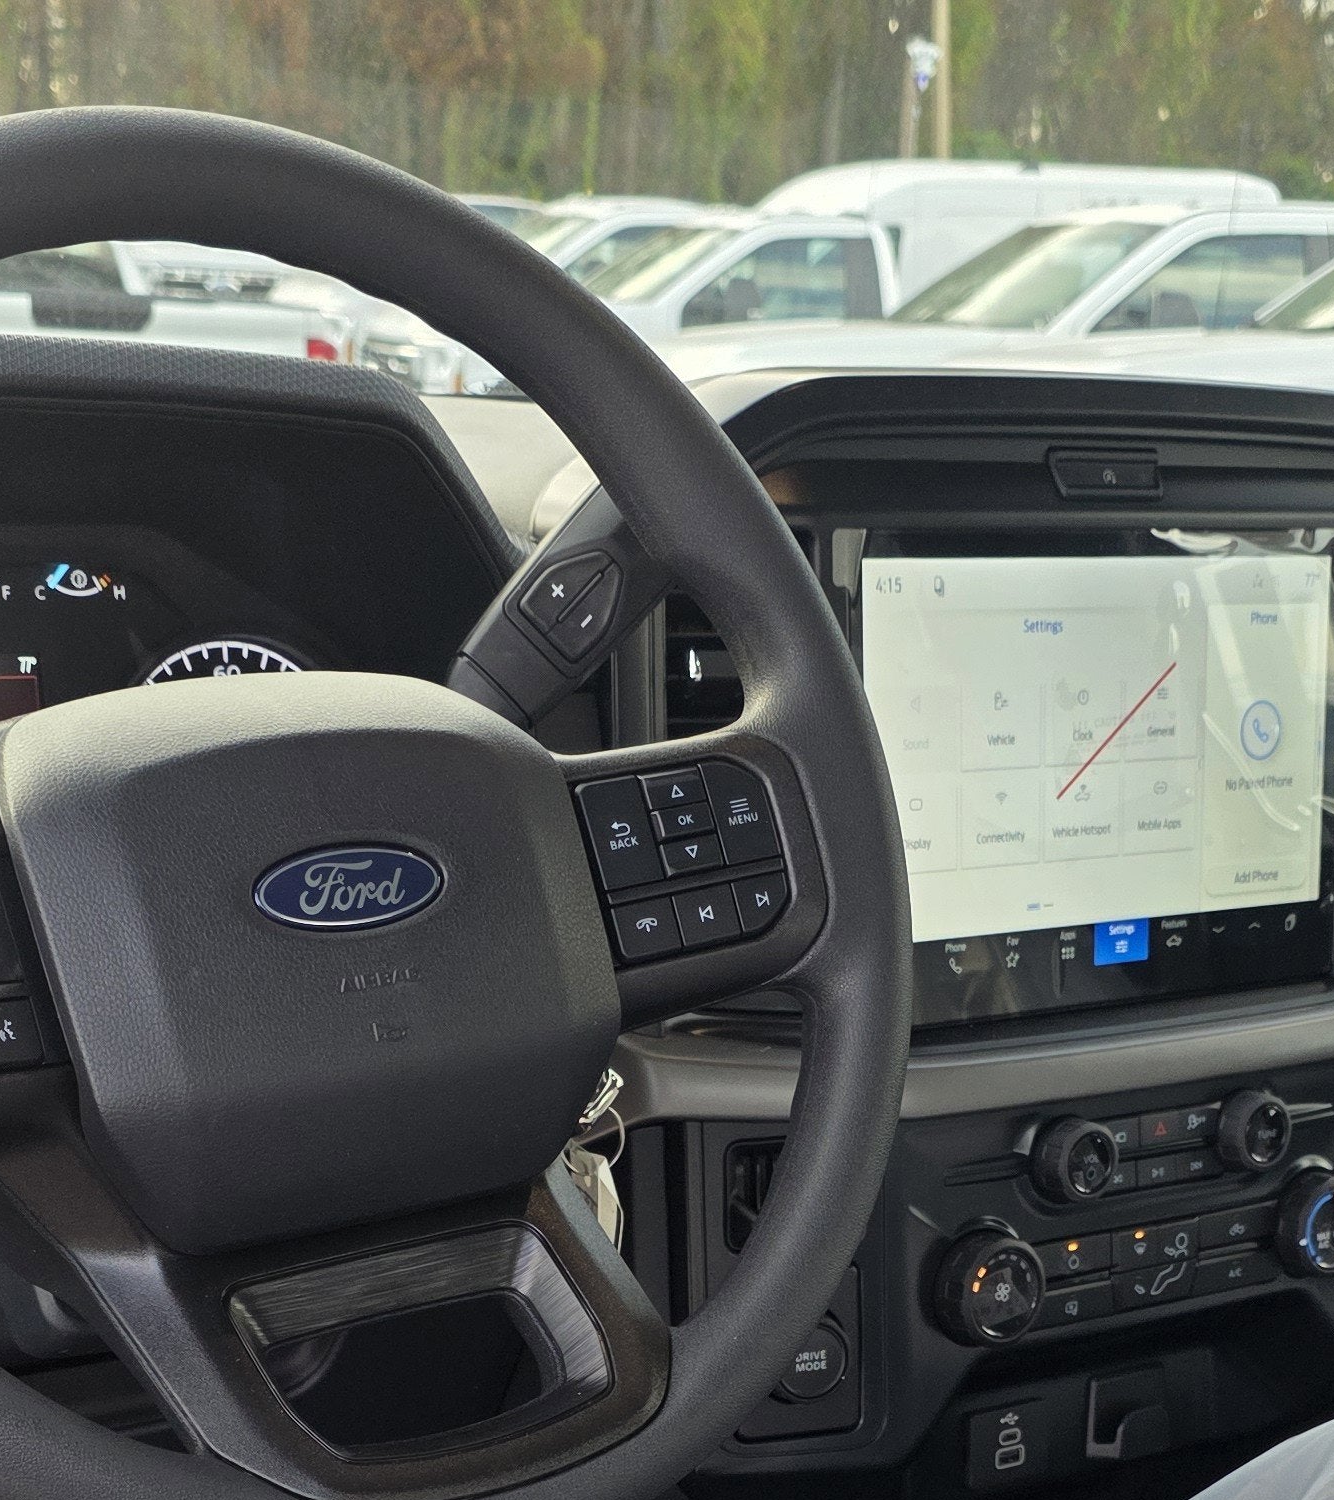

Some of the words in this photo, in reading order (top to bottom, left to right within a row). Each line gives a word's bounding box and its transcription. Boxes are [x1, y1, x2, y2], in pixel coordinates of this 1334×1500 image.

[875, 576, 902, 594] 4:15
[1, 585, 12, 601] F
[34, 585, 47, 601] C
[113, 585, 127, 601] H
[1250, 610, 1278, 625] Phone
[1023, 618, 1064, 635] Settings
[1072, 727, 1094, 742] Clock
[1147, 724, 1175, 738] General
[987, 733, 1016, 746] Vehicle
[1266, 776, 1294, 789] Phone
[677, 814, 694, 826] OK
[728, 811, 759, 827] MENU
[976, 831, 1025, 845] Connectivity
[1052, 826, 1079, 839] Vehicle
[1080, 824, 1111, 837] Hotspot
[609, 836, 639, 851] BACK
[1234, 871, 1251, 884] Add
[1252, 870, 1279, 882] Phone
[299, 859, 406, 916] Ford
[795, 1360, 827, 1373] MODE
